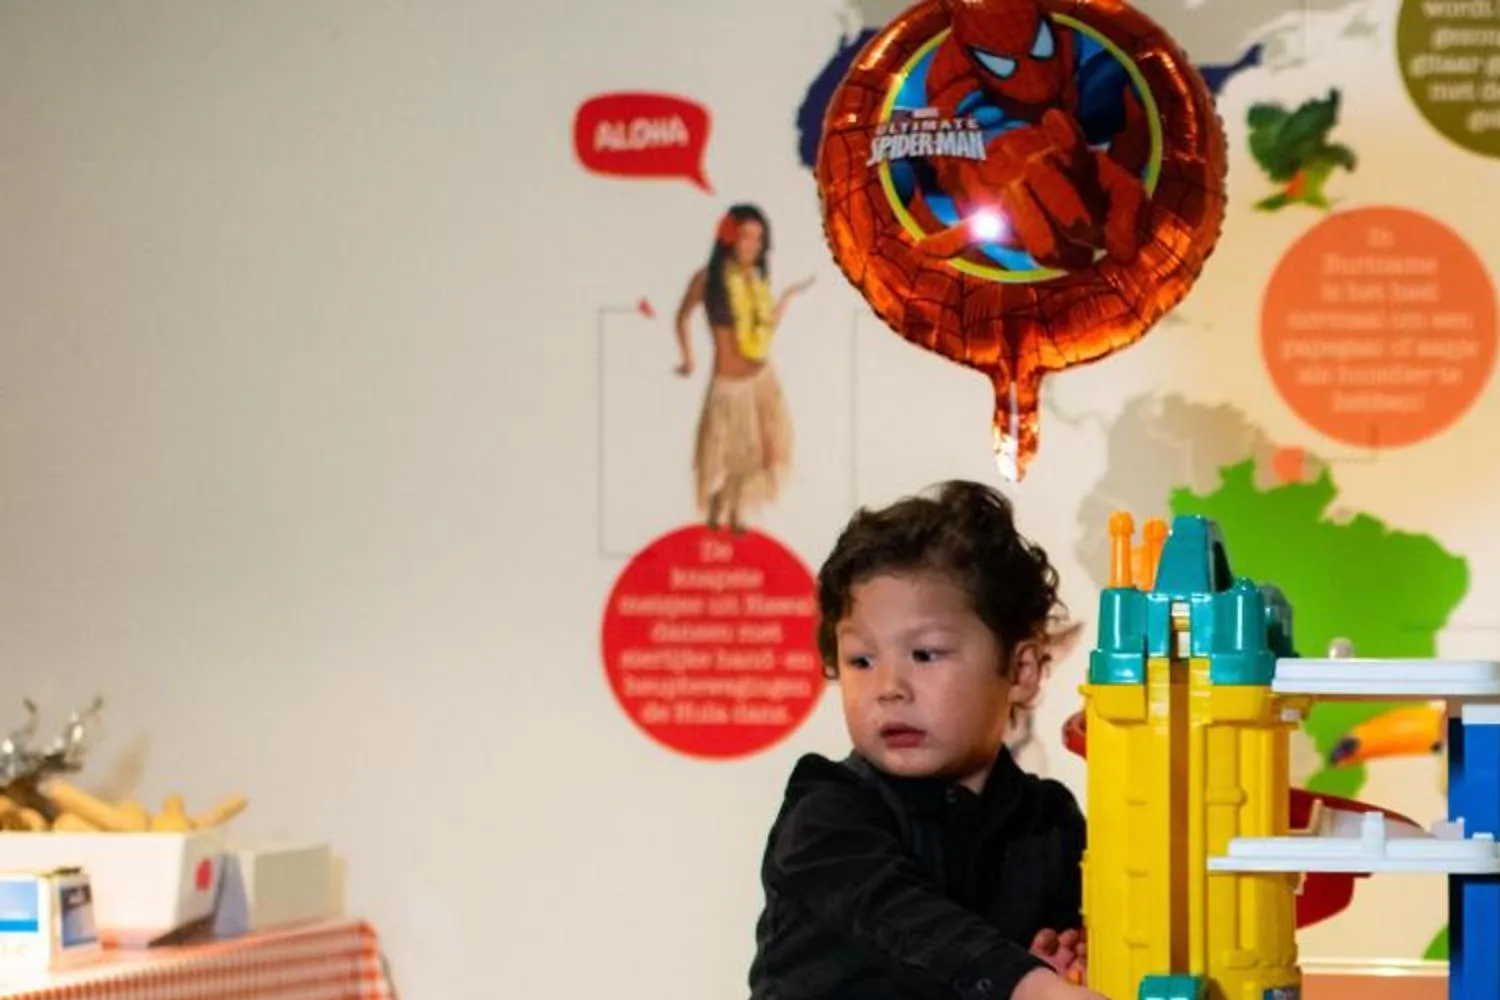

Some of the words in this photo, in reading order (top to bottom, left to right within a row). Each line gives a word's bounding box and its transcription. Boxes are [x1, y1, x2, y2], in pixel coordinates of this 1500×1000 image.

[1428, 81, 1475, 101] met
[594, 113, 689, 152] ALOHA
[876, 117, 978, 135] ULTIMATE
[866, 131, 986, 167] SPIDER-MAN
[651, 620, 734, 643] dansen
